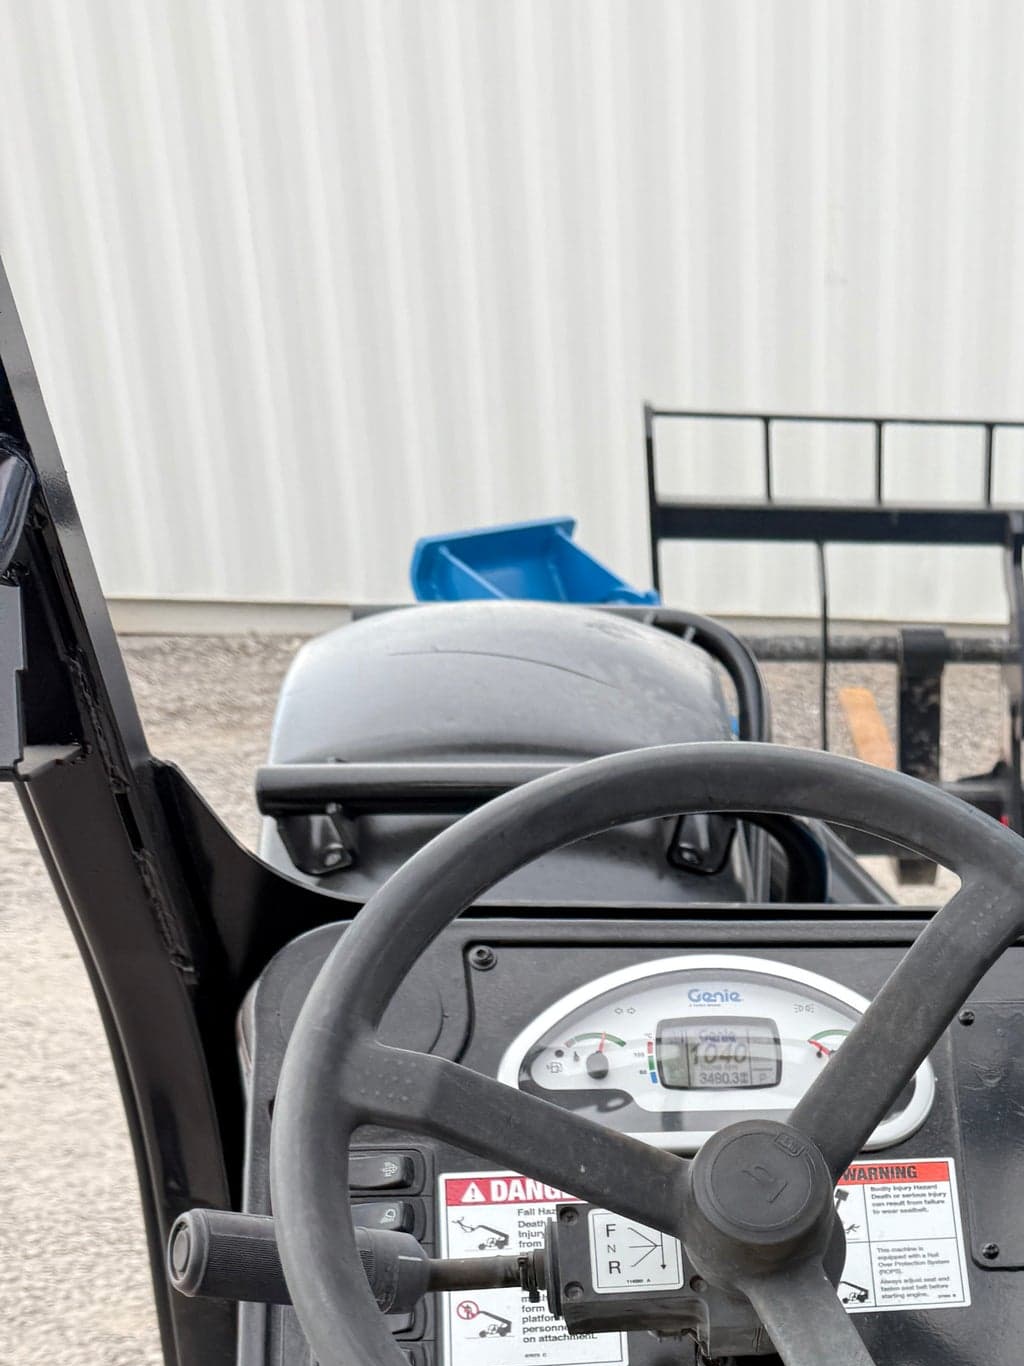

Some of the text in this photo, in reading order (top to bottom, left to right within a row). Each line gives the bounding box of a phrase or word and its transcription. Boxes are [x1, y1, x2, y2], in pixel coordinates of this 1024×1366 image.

[688, 988, 742, 1003] Genie
[843, 1166, 917, 1181] WARNING
[490, 1177, 577, 1201] DANG
[518, 1208, 535, 1216] Fall
[606, 1224, 616, 1237] F
[519, 1240, 543, 1248] from
[607, 1244, 617, 1253] N
[609, 1260, 621, 1274] R
[522, 1305, 545, 1313] form
[522, 1325, 568, 1335] personn
